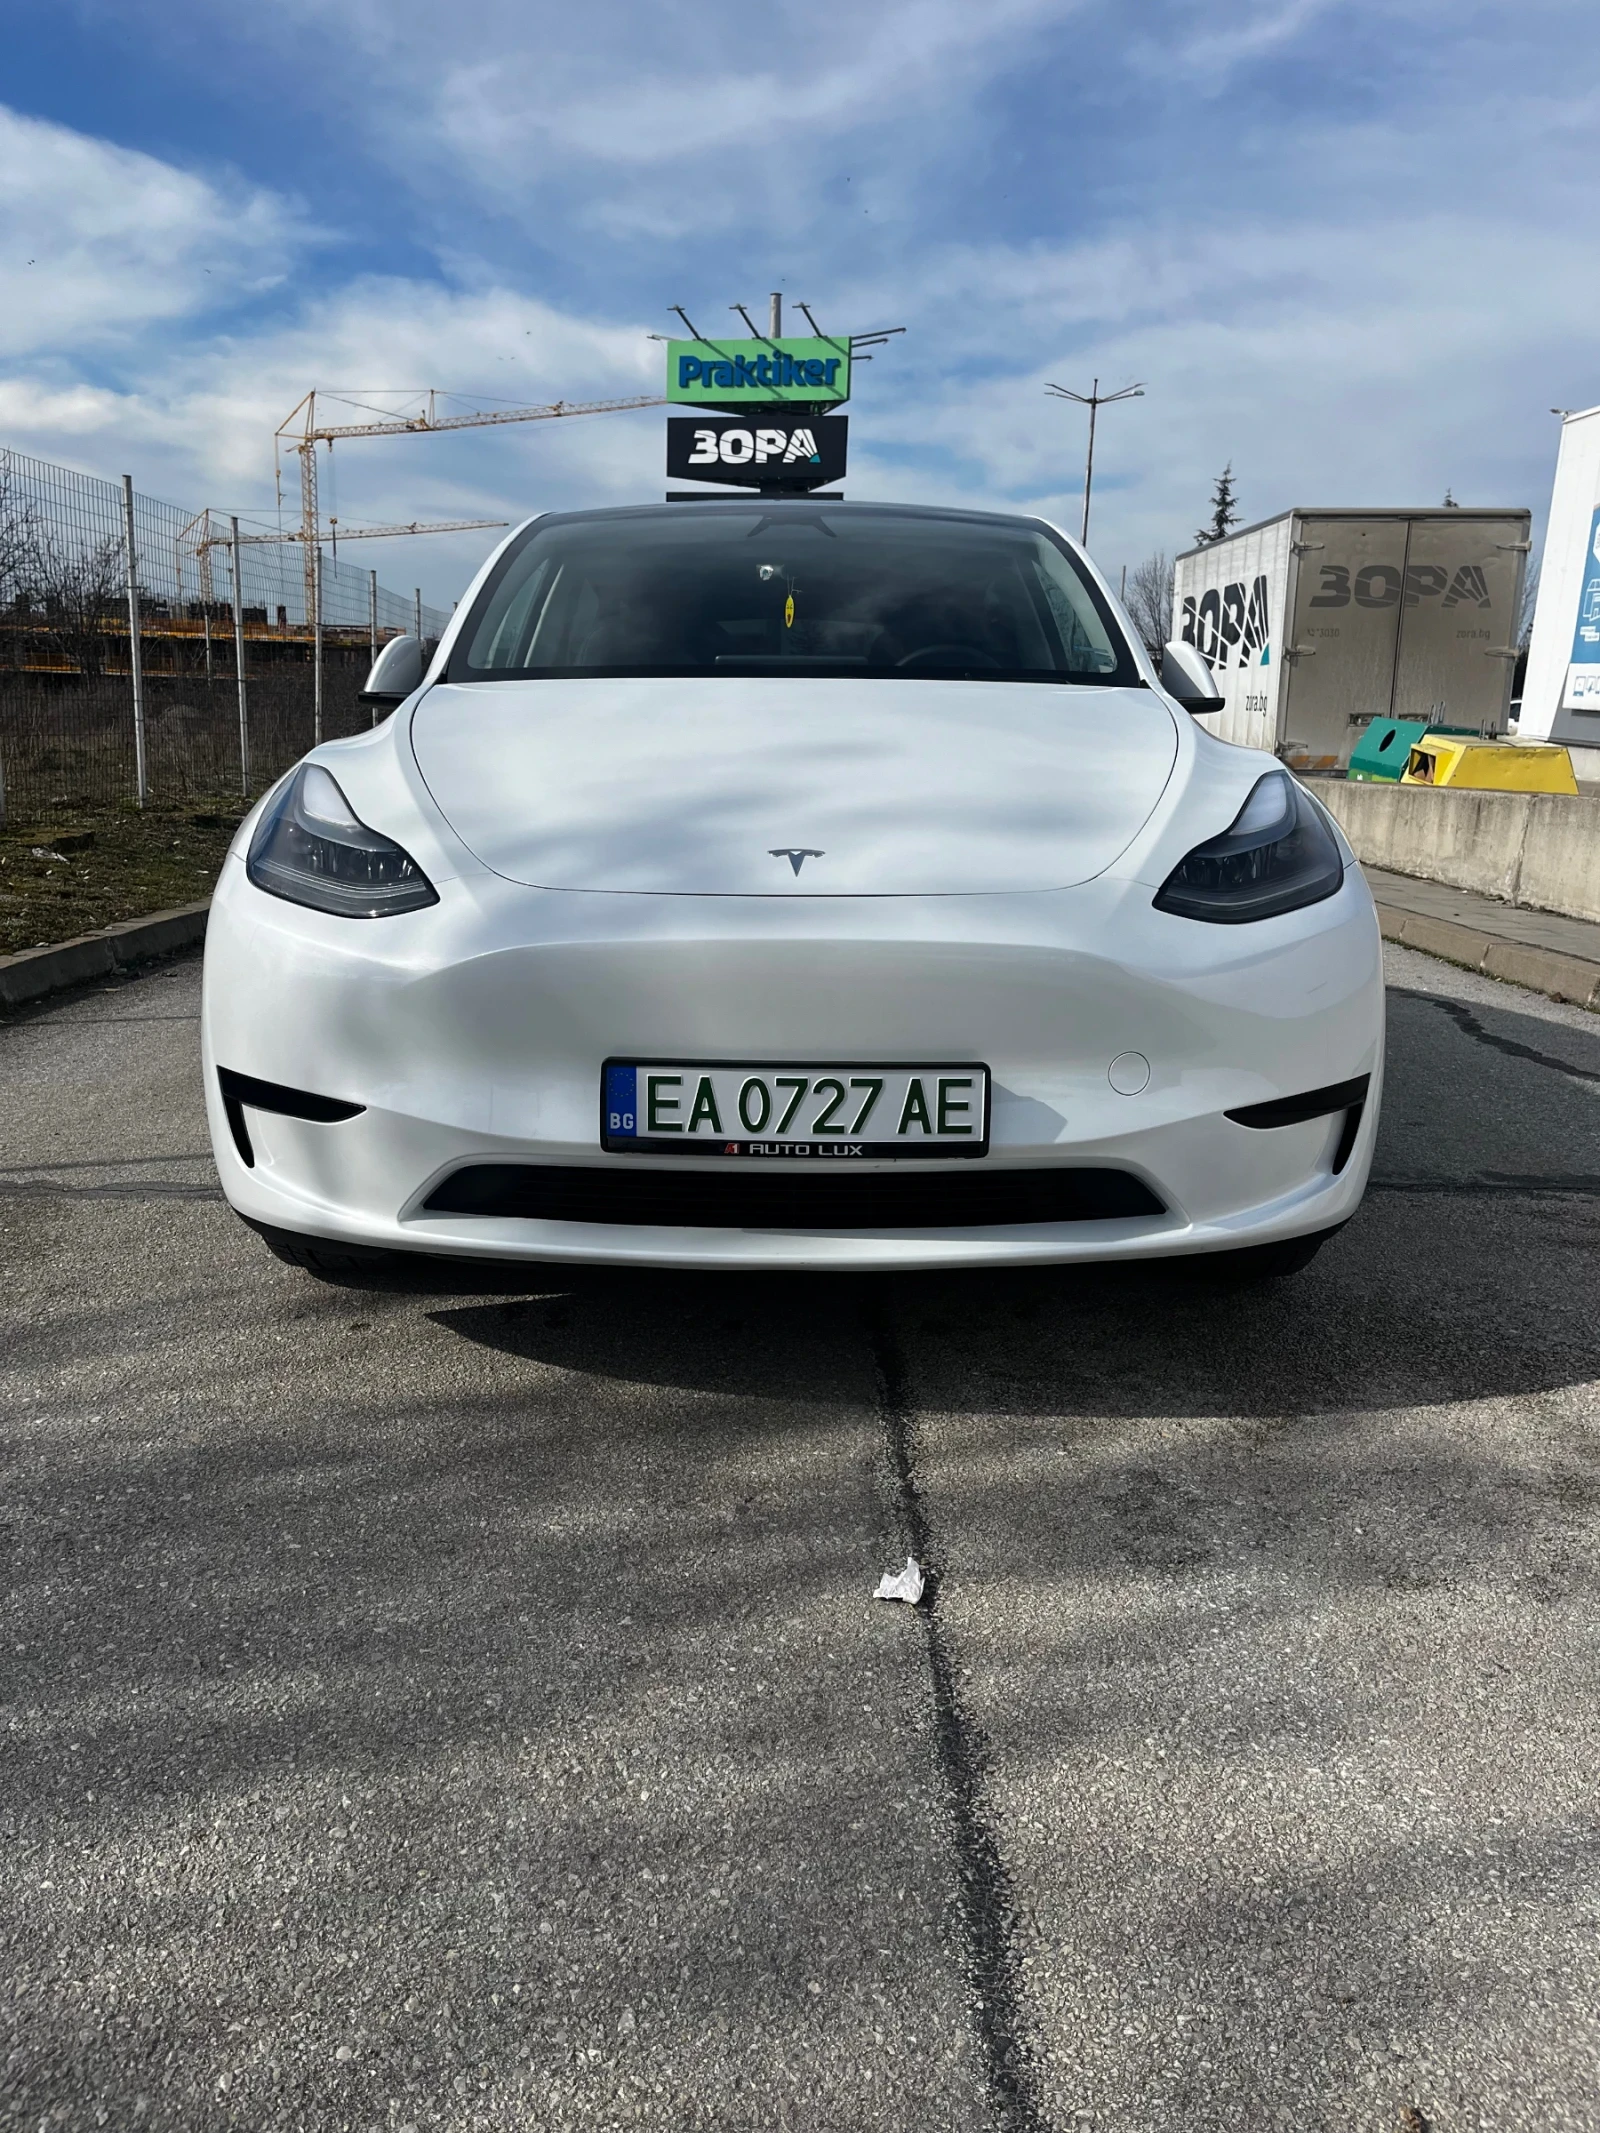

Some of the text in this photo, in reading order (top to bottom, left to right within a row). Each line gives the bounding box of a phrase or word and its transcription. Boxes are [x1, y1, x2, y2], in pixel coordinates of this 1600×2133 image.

[679, 350, 841, 389] Praktiker
[688, 429, 821, 465] ЗОРА
[1308, 565, 1492, 609] ЗОРА
[1456, 628, 1491, 640] zora.bg
[609, 1112, 634, 1130] BG
[646, 1074, 974, 1136] EA 0727 AE
[750, 1143, 810, 1155] AUTO
[818, 1144, 863, 1156] LUX
